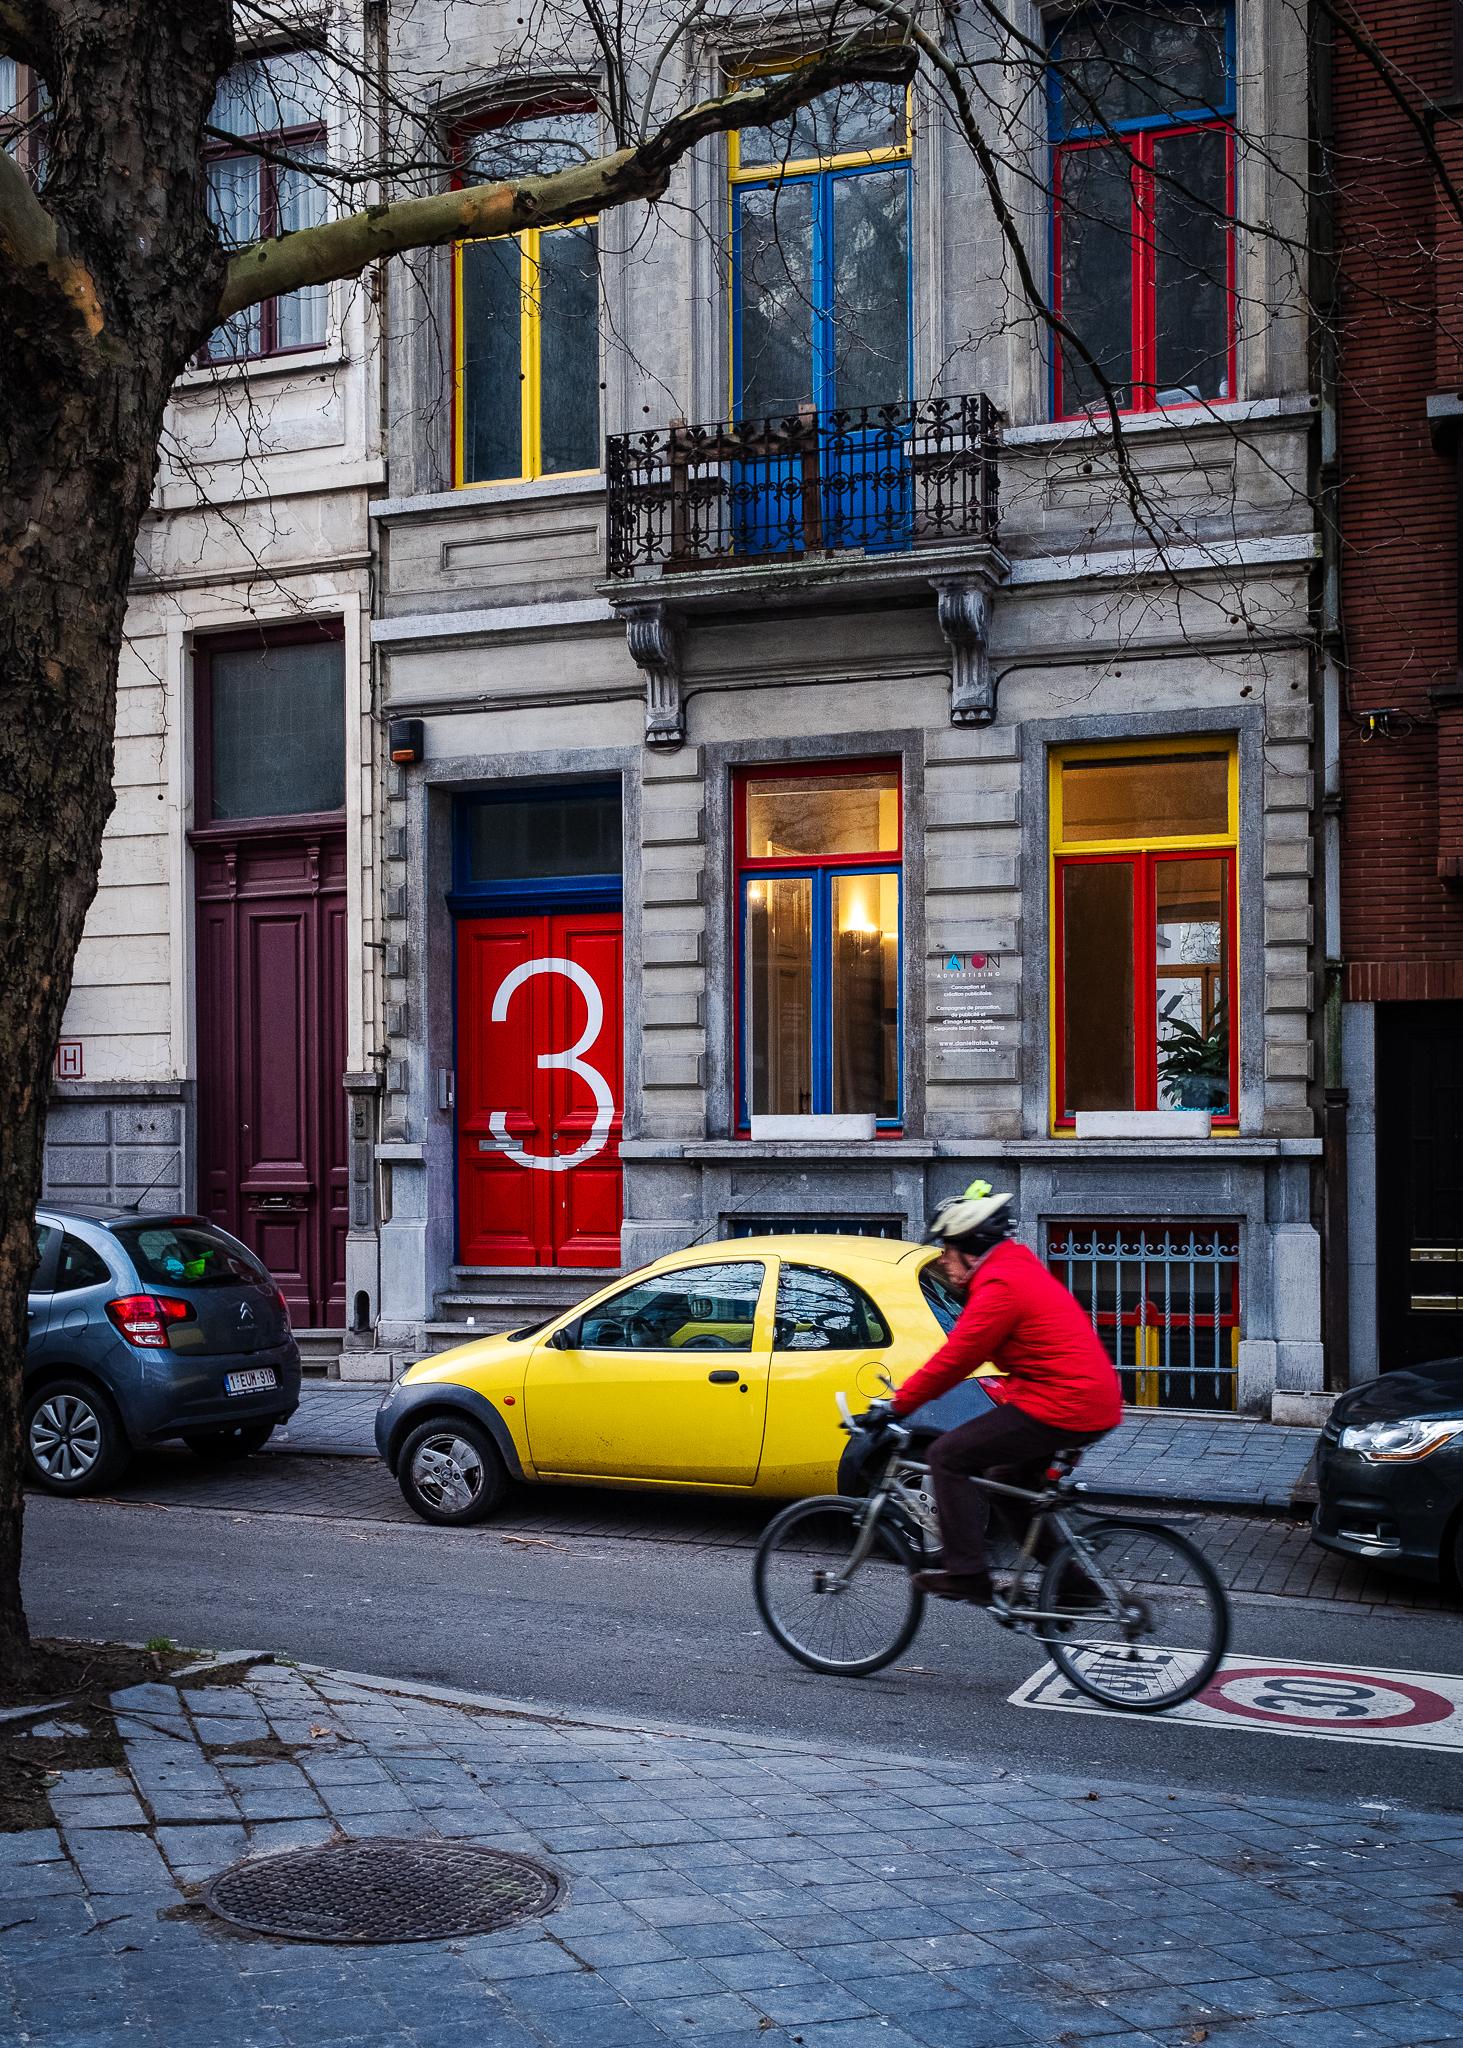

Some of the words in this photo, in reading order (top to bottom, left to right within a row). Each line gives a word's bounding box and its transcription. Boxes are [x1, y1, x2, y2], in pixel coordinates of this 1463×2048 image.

[63, 1049, 77, 1071] H
[489, 957, 614, 1171] 3
[1253, 1678, 1376, 1717] 30
